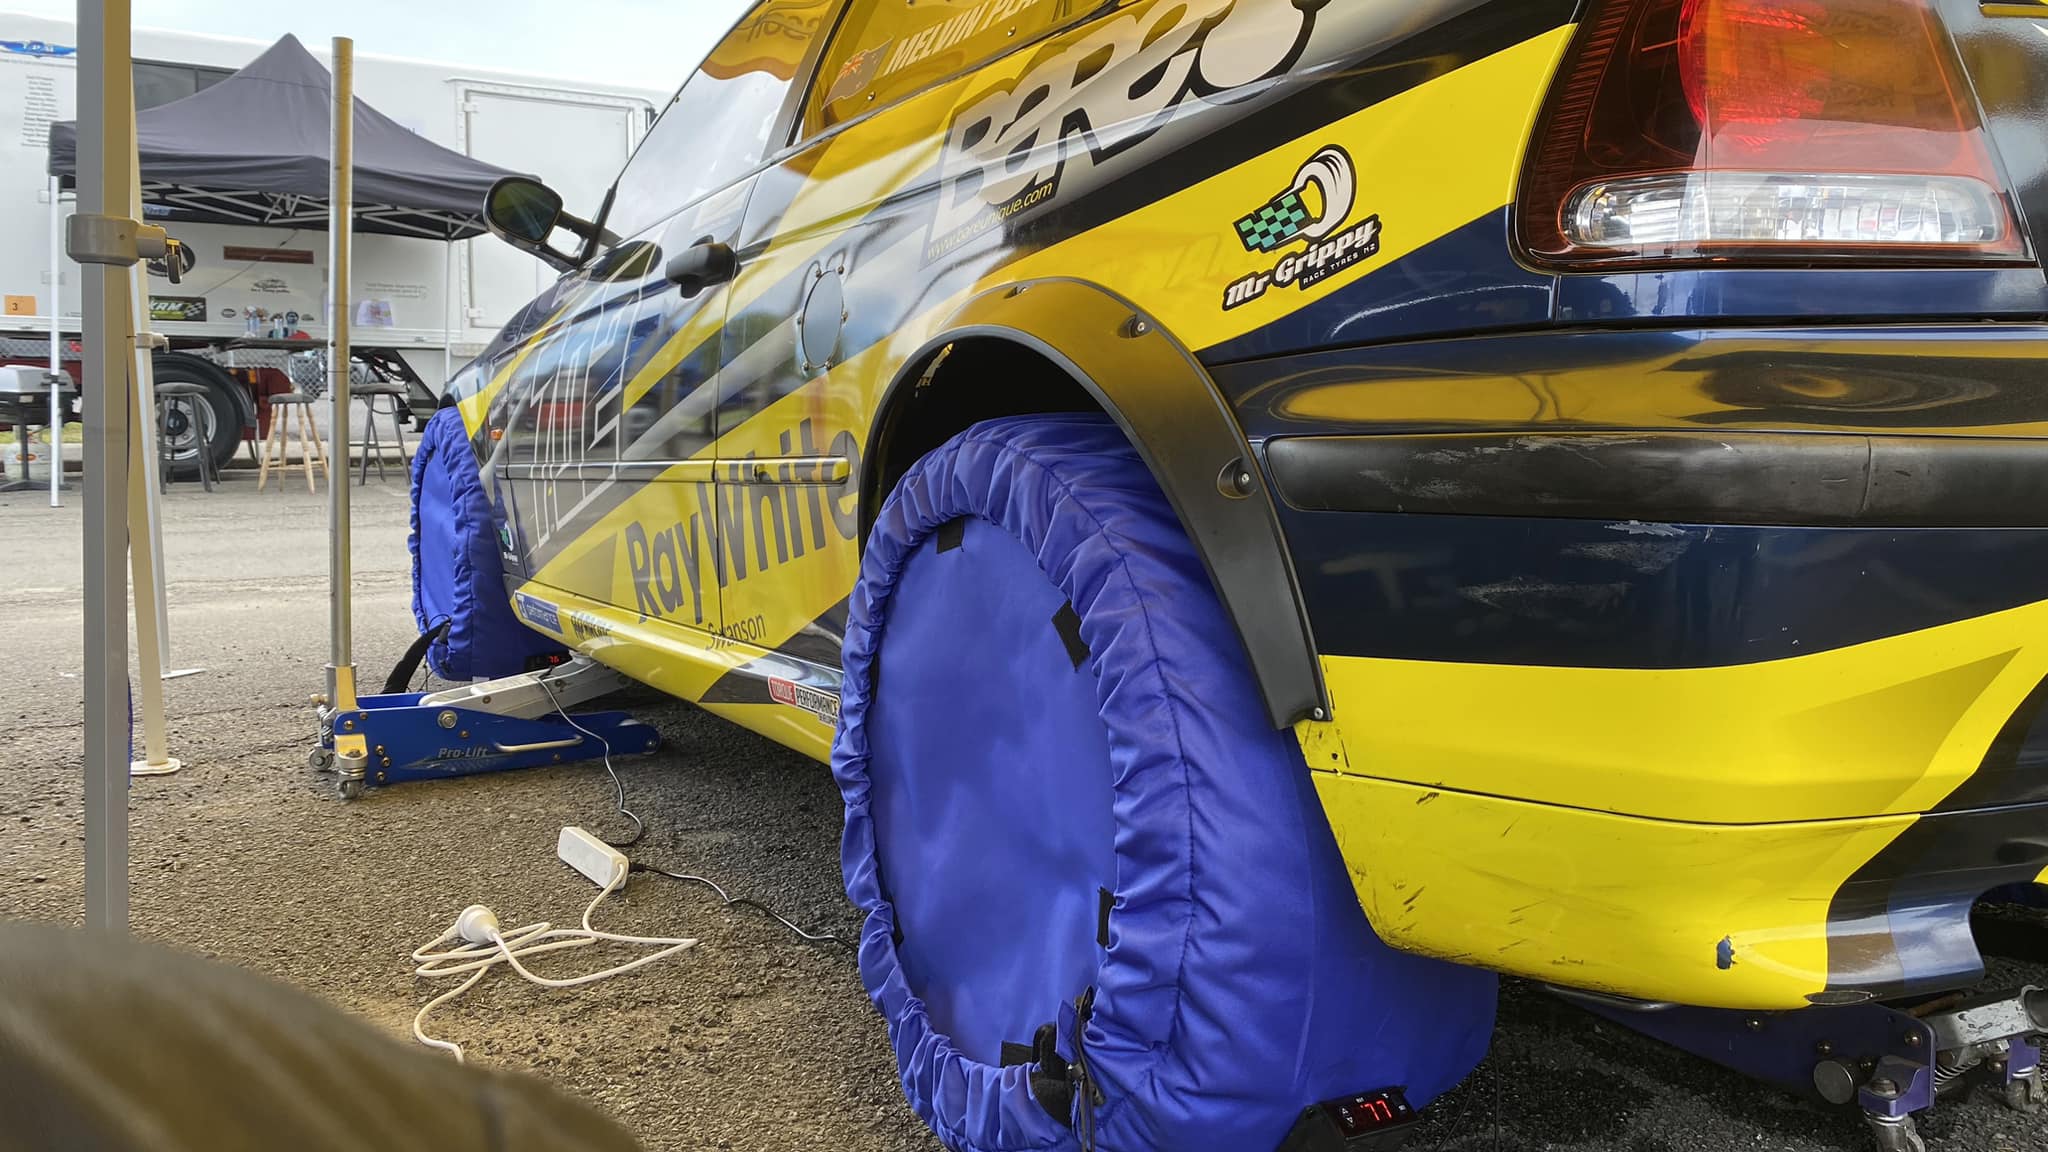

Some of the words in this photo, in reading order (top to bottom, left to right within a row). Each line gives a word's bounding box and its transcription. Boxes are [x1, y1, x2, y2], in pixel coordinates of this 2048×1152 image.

[882, 2, 985, 76] MELVIN
[1275, 220, 1377, 283] Grippy
[1303, 268, 1326, 285] RACE
[1330, 252, 1359, 270] TYRES
[705, 613, 767, 651] Swanson
[438, 747, 489, 758] Pro-Lift
[1363, 1099, 1393, 1121] 77
